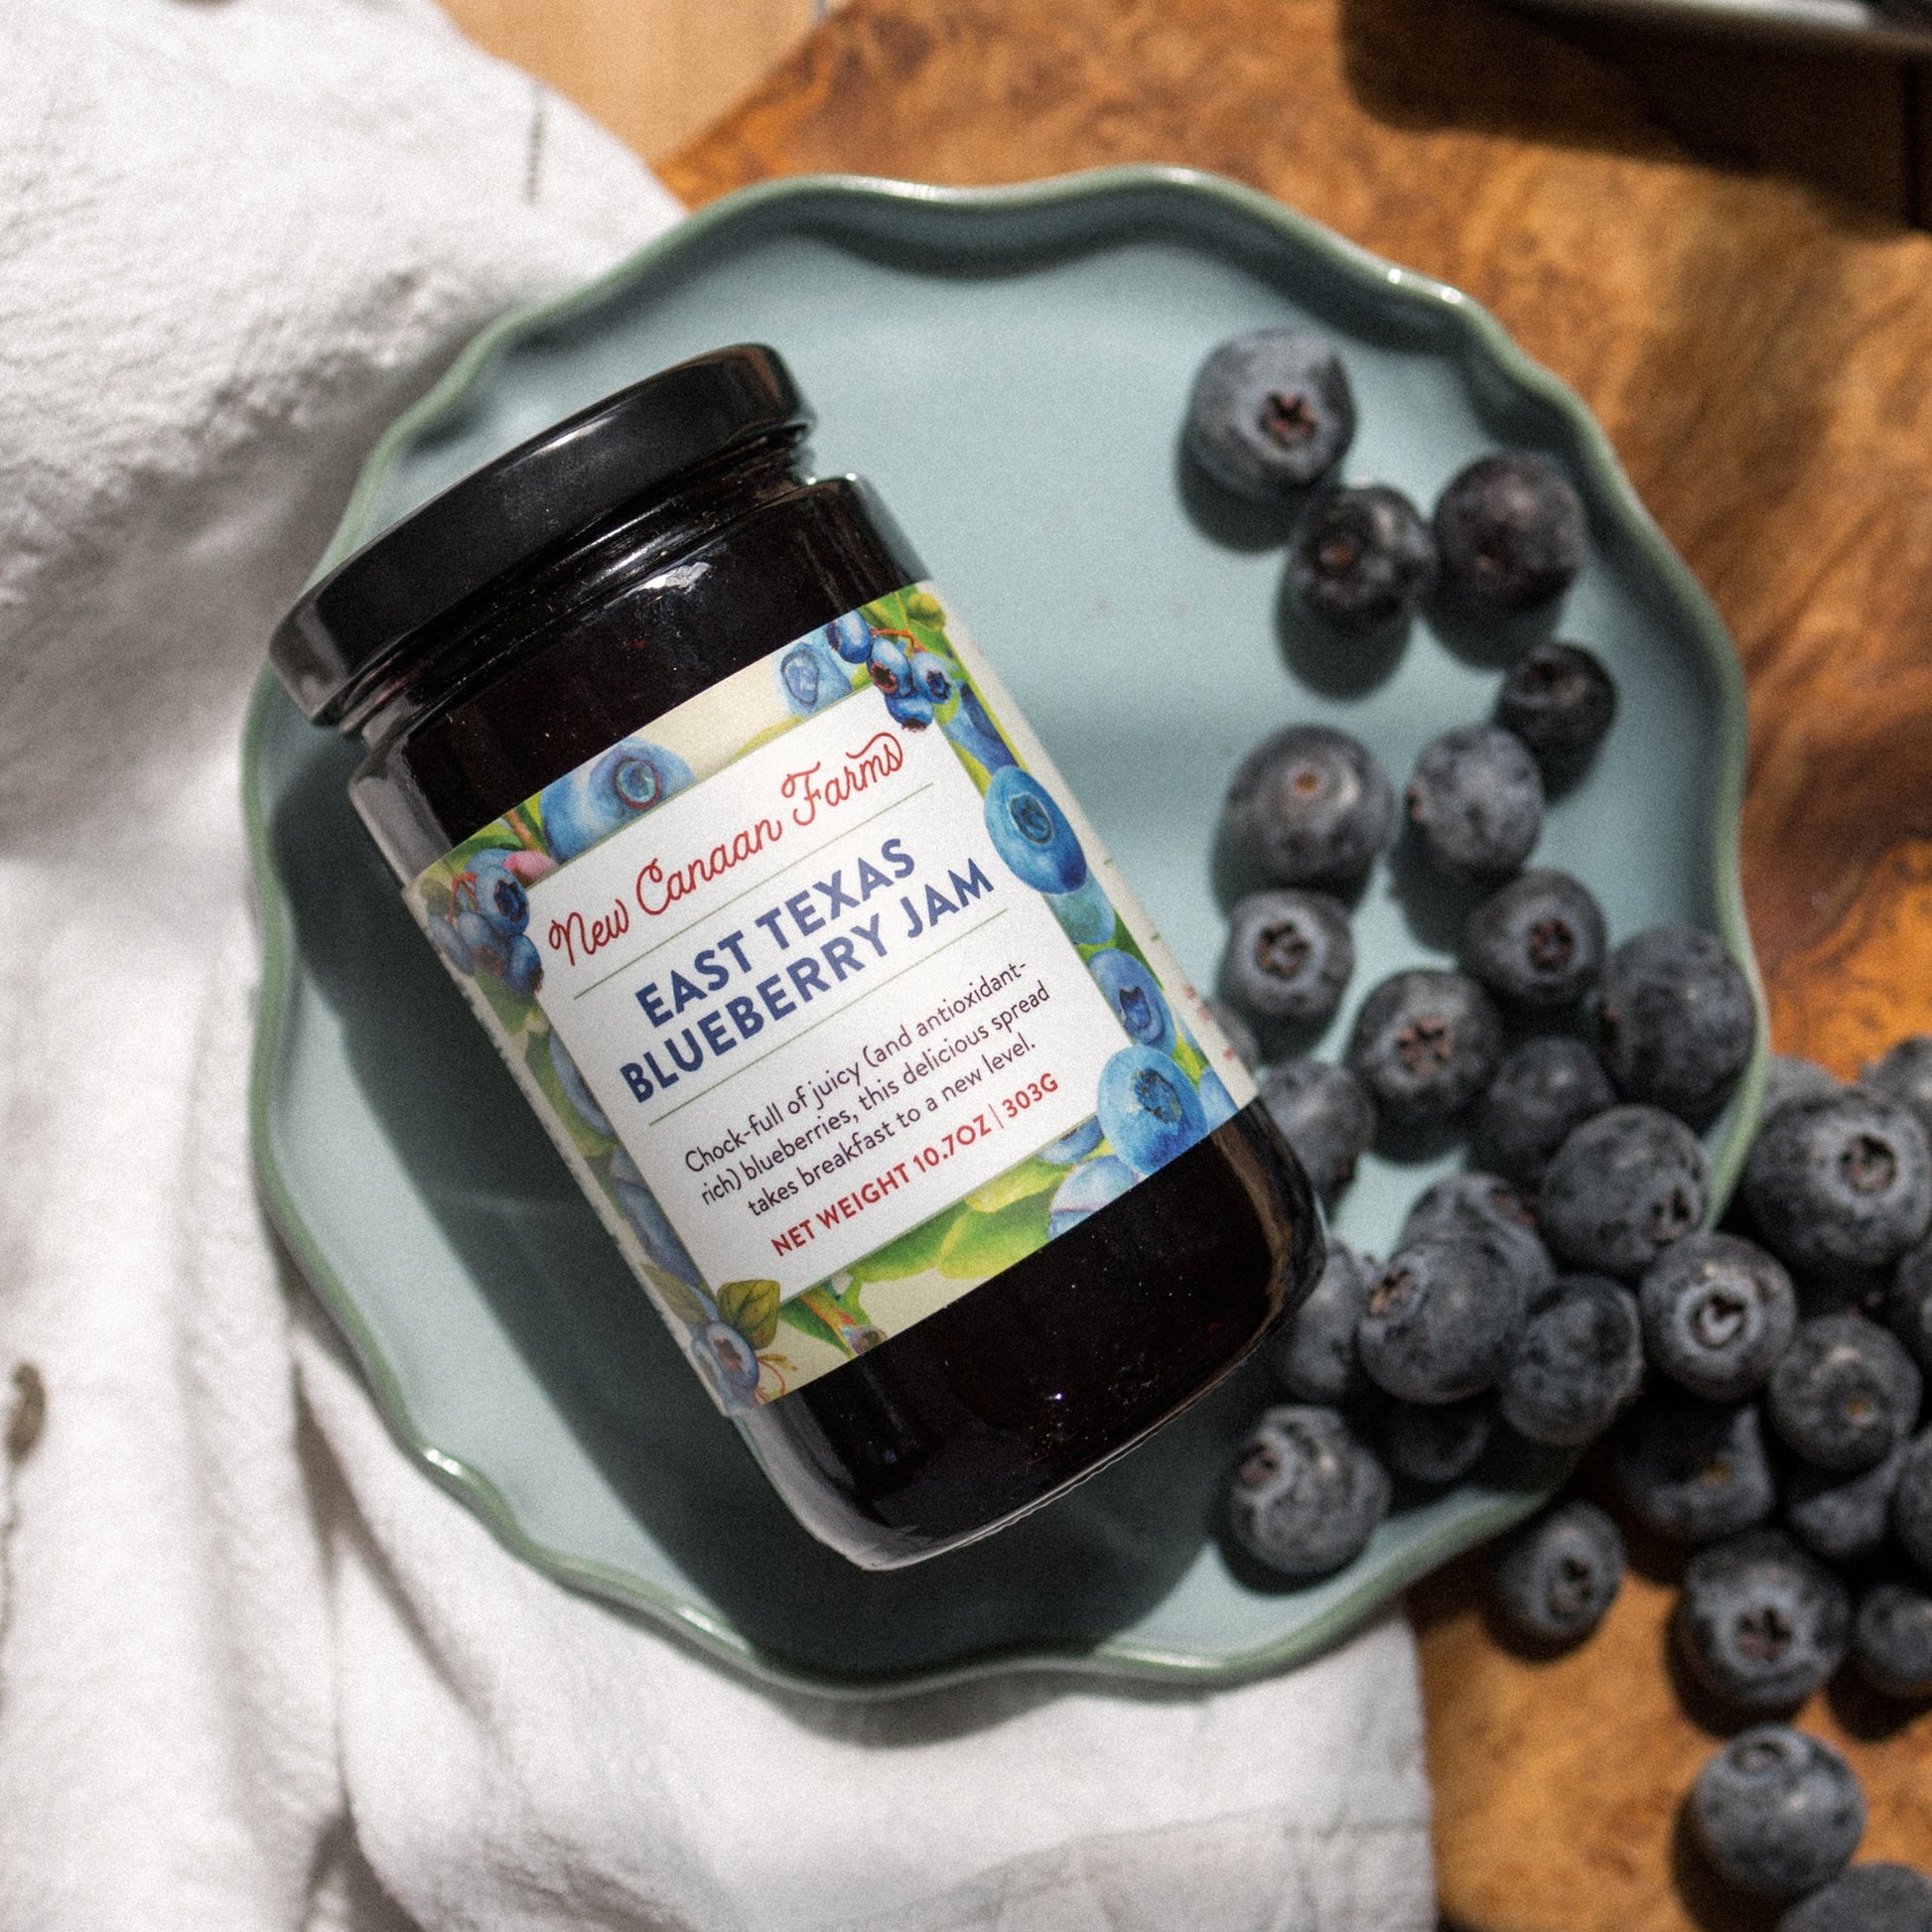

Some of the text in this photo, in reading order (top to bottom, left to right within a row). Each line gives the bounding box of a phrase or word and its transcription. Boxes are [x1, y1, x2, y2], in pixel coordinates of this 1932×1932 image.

[547, 731, 904, 967] New Canaan Farms
[634, 838, 915, 1029] EAST TEXAS
[619, 857, 995, 1104] BLUEBERRY JAM
[684, 963, 1027, 1173] Chock-full of juicy (and antioxidant-
[701, 979, 1050, 1206] rich) blueberries, this delicious spread
[747, 1032, 1035, 1217] takes breakfast to a new level.
[770, 1218, 816, 1258] NET
[815, 1162, 910, 1230] WEIGHT
[912, 1113, 993, 1173] 10.7OZ
[1001, 1072, 1059, 1119] 303G
